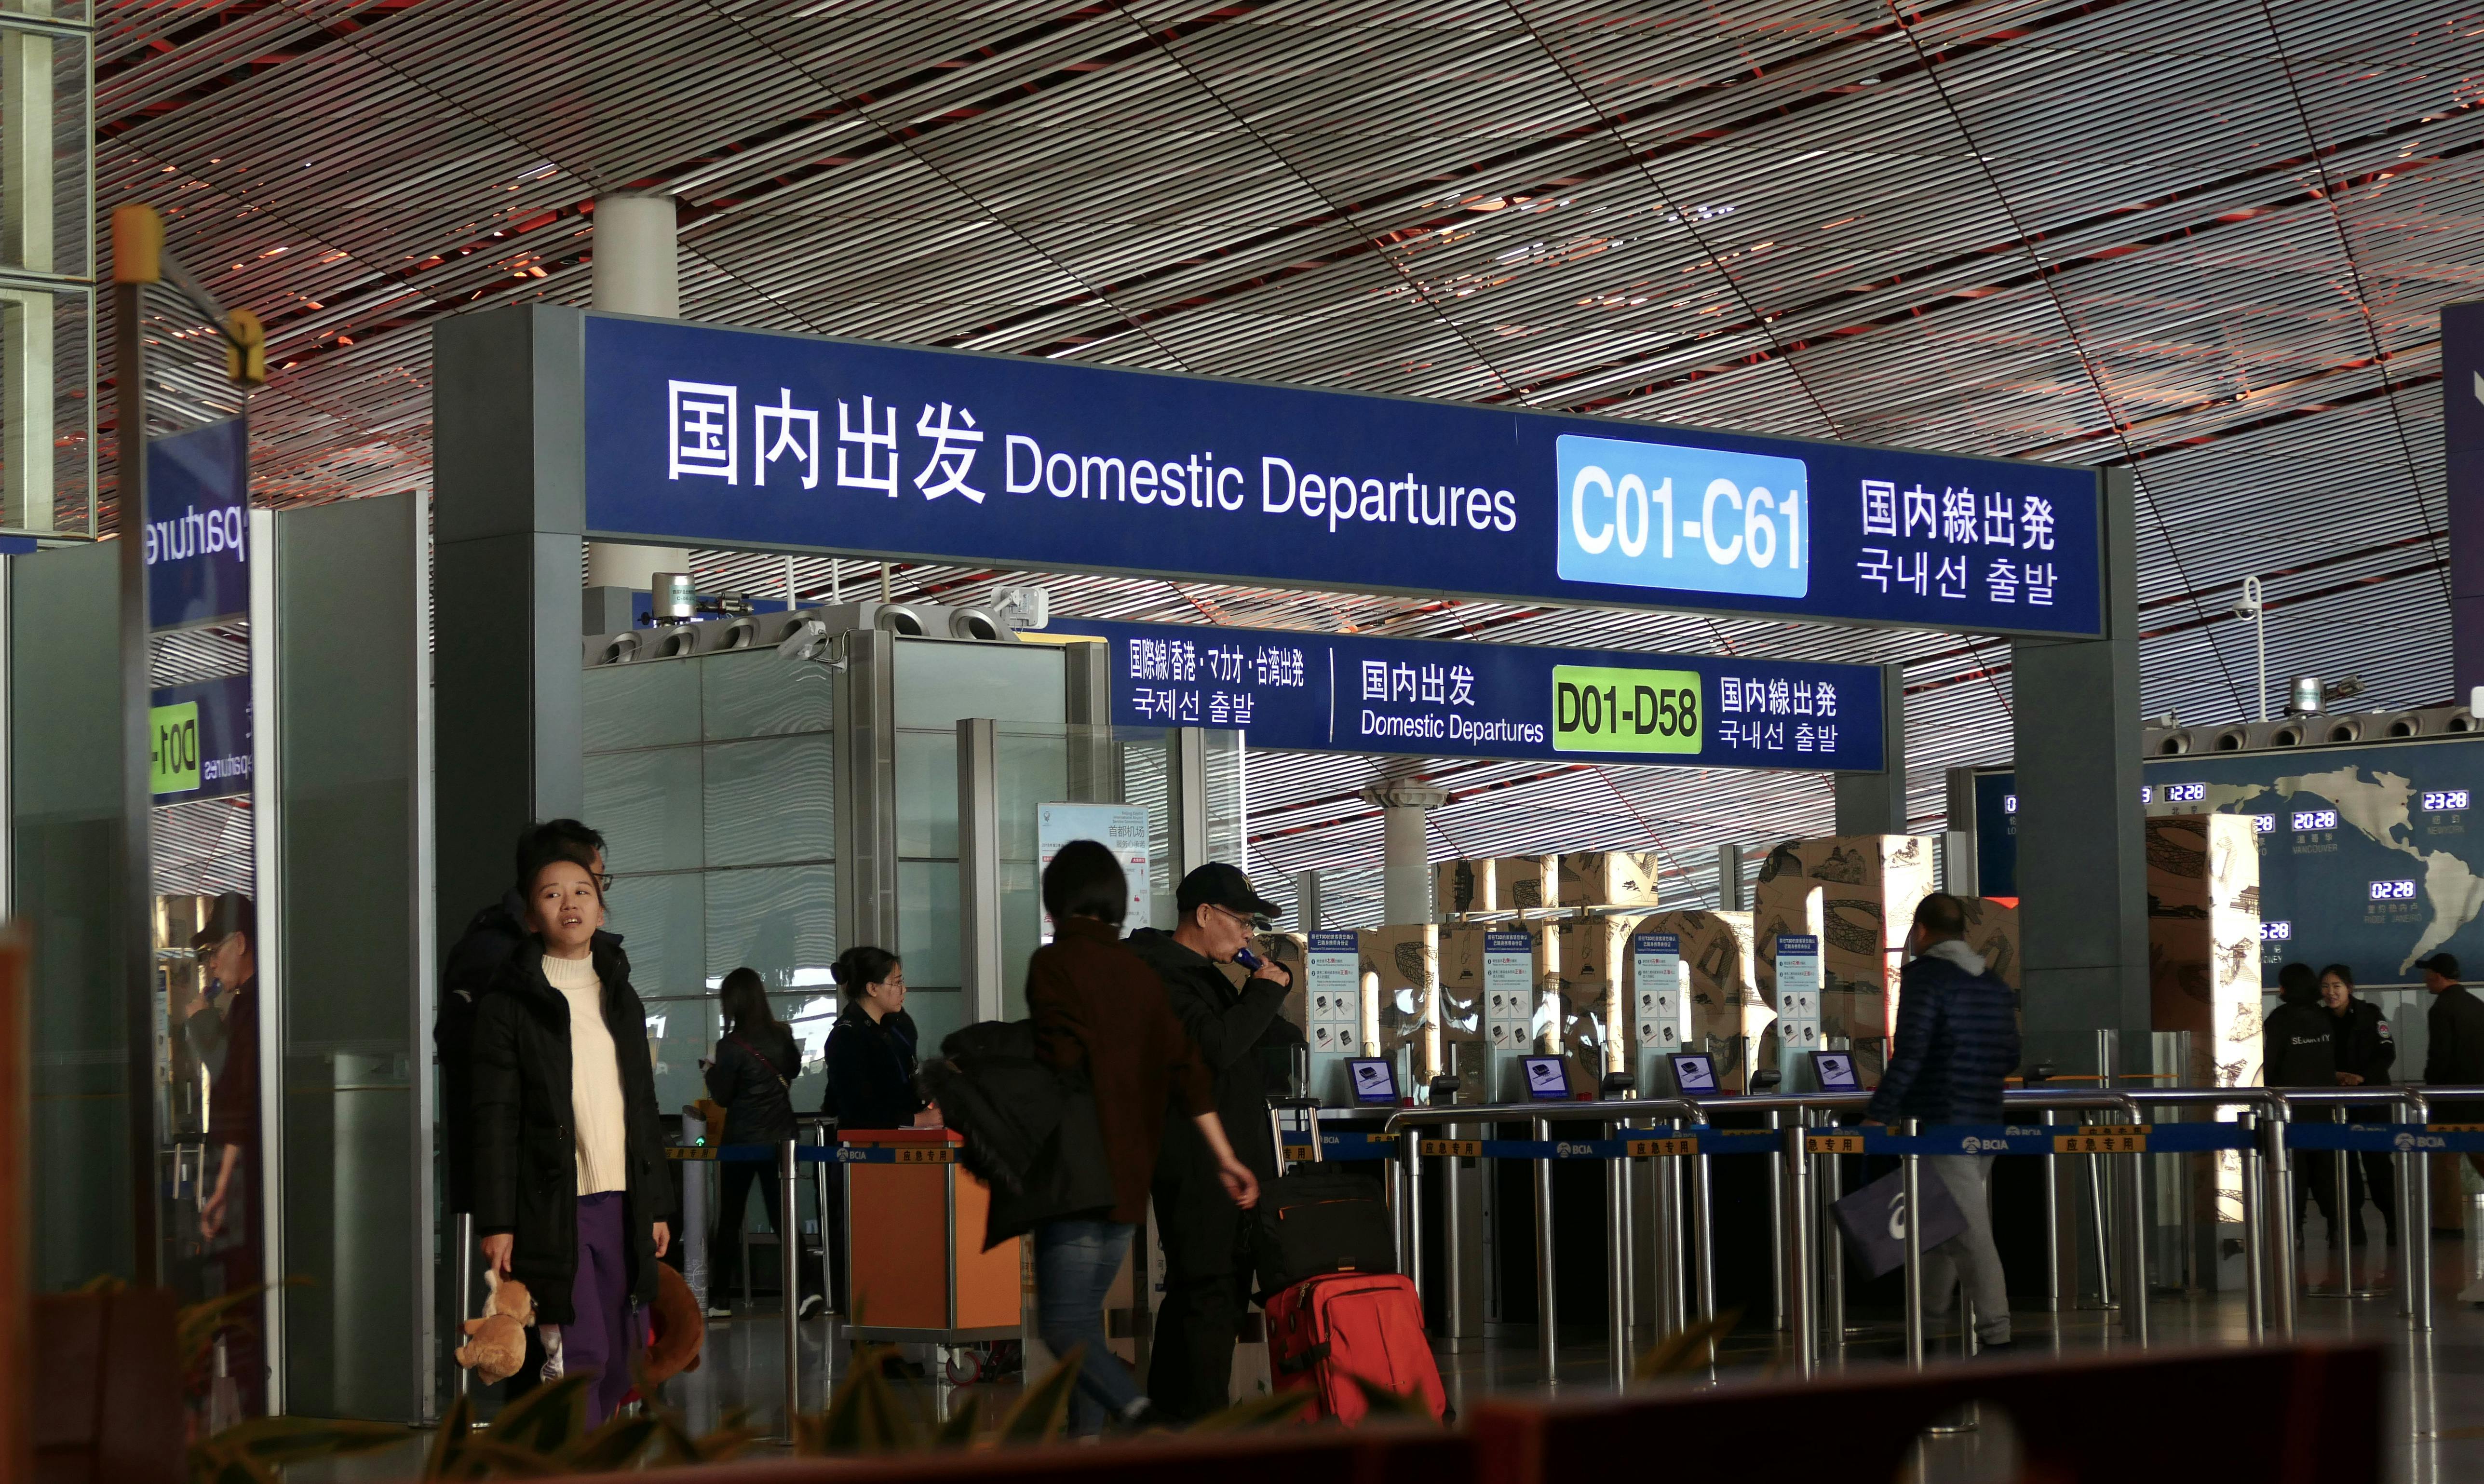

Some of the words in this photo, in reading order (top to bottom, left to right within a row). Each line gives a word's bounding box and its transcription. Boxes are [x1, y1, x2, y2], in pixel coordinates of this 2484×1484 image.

[668, 379, 986, 504] 国内出发
[1006, 434, 1244, 511] Domestic
[1262, 456, 1516, 532] Departures
[1572, 465, 1799, 569] C01-C61
[1862, 479, 2054, 551] 国内線出発
[1857, 548, 1966, 598] 국내선
[1986, 558, 2058, 605] 출발
[1362, 660, 1475, 706] 国内出发
[1720, 676, 1837, 717] 国内線出発
[1133, 688, 1200, 721] 국제선
[1209, 691, 1255, 724] 출발
[1558, 682, 1697, 737] D01-D58
[1362, 709, 1444, 739] Domestic
[1449, 714, 1543, 746] Departures
[1718, 720, 1783, 750] 국내선
[1795, 723, 1838, 752] 출발
[1108, 825, 1145, 837] 首都机场
[2293, 844, 2338, 854] VANCOUVER
[850, 1151, 866, 1160] BCIA
[904, 1150, 946, 1161] 应急专用
[1426, 1142, 1473, 1154] 应急专用
[1572, 1145, 1593, 1154] BCIA
[1637, 1140, 1688, 1154] 应急专用
[1983, 1139, 2009, 1150] BCIA
[2067, 1137, 2134, 1151] 应急专用
